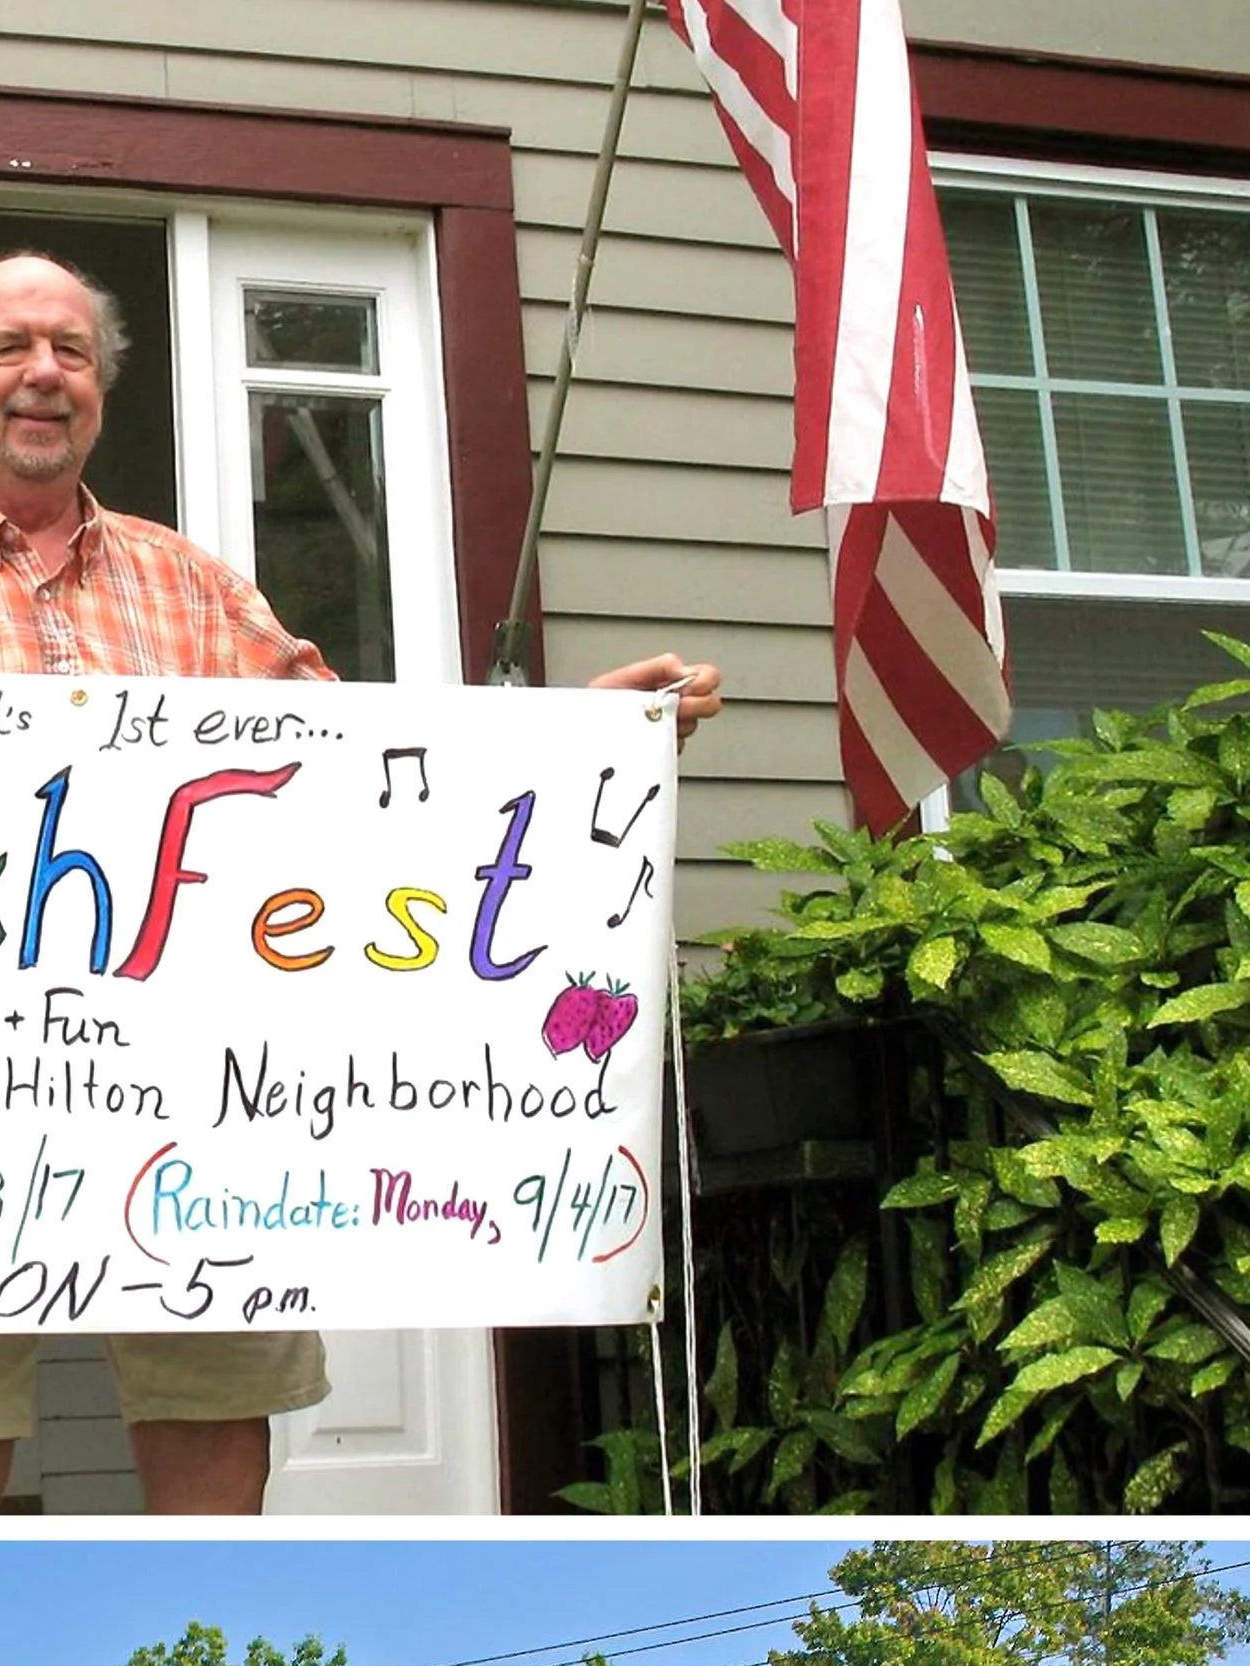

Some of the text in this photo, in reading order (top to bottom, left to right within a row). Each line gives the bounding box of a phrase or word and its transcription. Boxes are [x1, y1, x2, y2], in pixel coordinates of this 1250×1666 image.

[98, 690, 169, 752] 1st
[43, 987, 130, 1047] Fun
[5, 1056, 170, 1120] Hilton
[212, 1041, 619, 1140] Neighborhood
[123, 1141, 359, 1266] (Raindate:
[369, 1168, 502, 1245] Monday,
[513, 1145, 650, 1263] 9/4/17)
